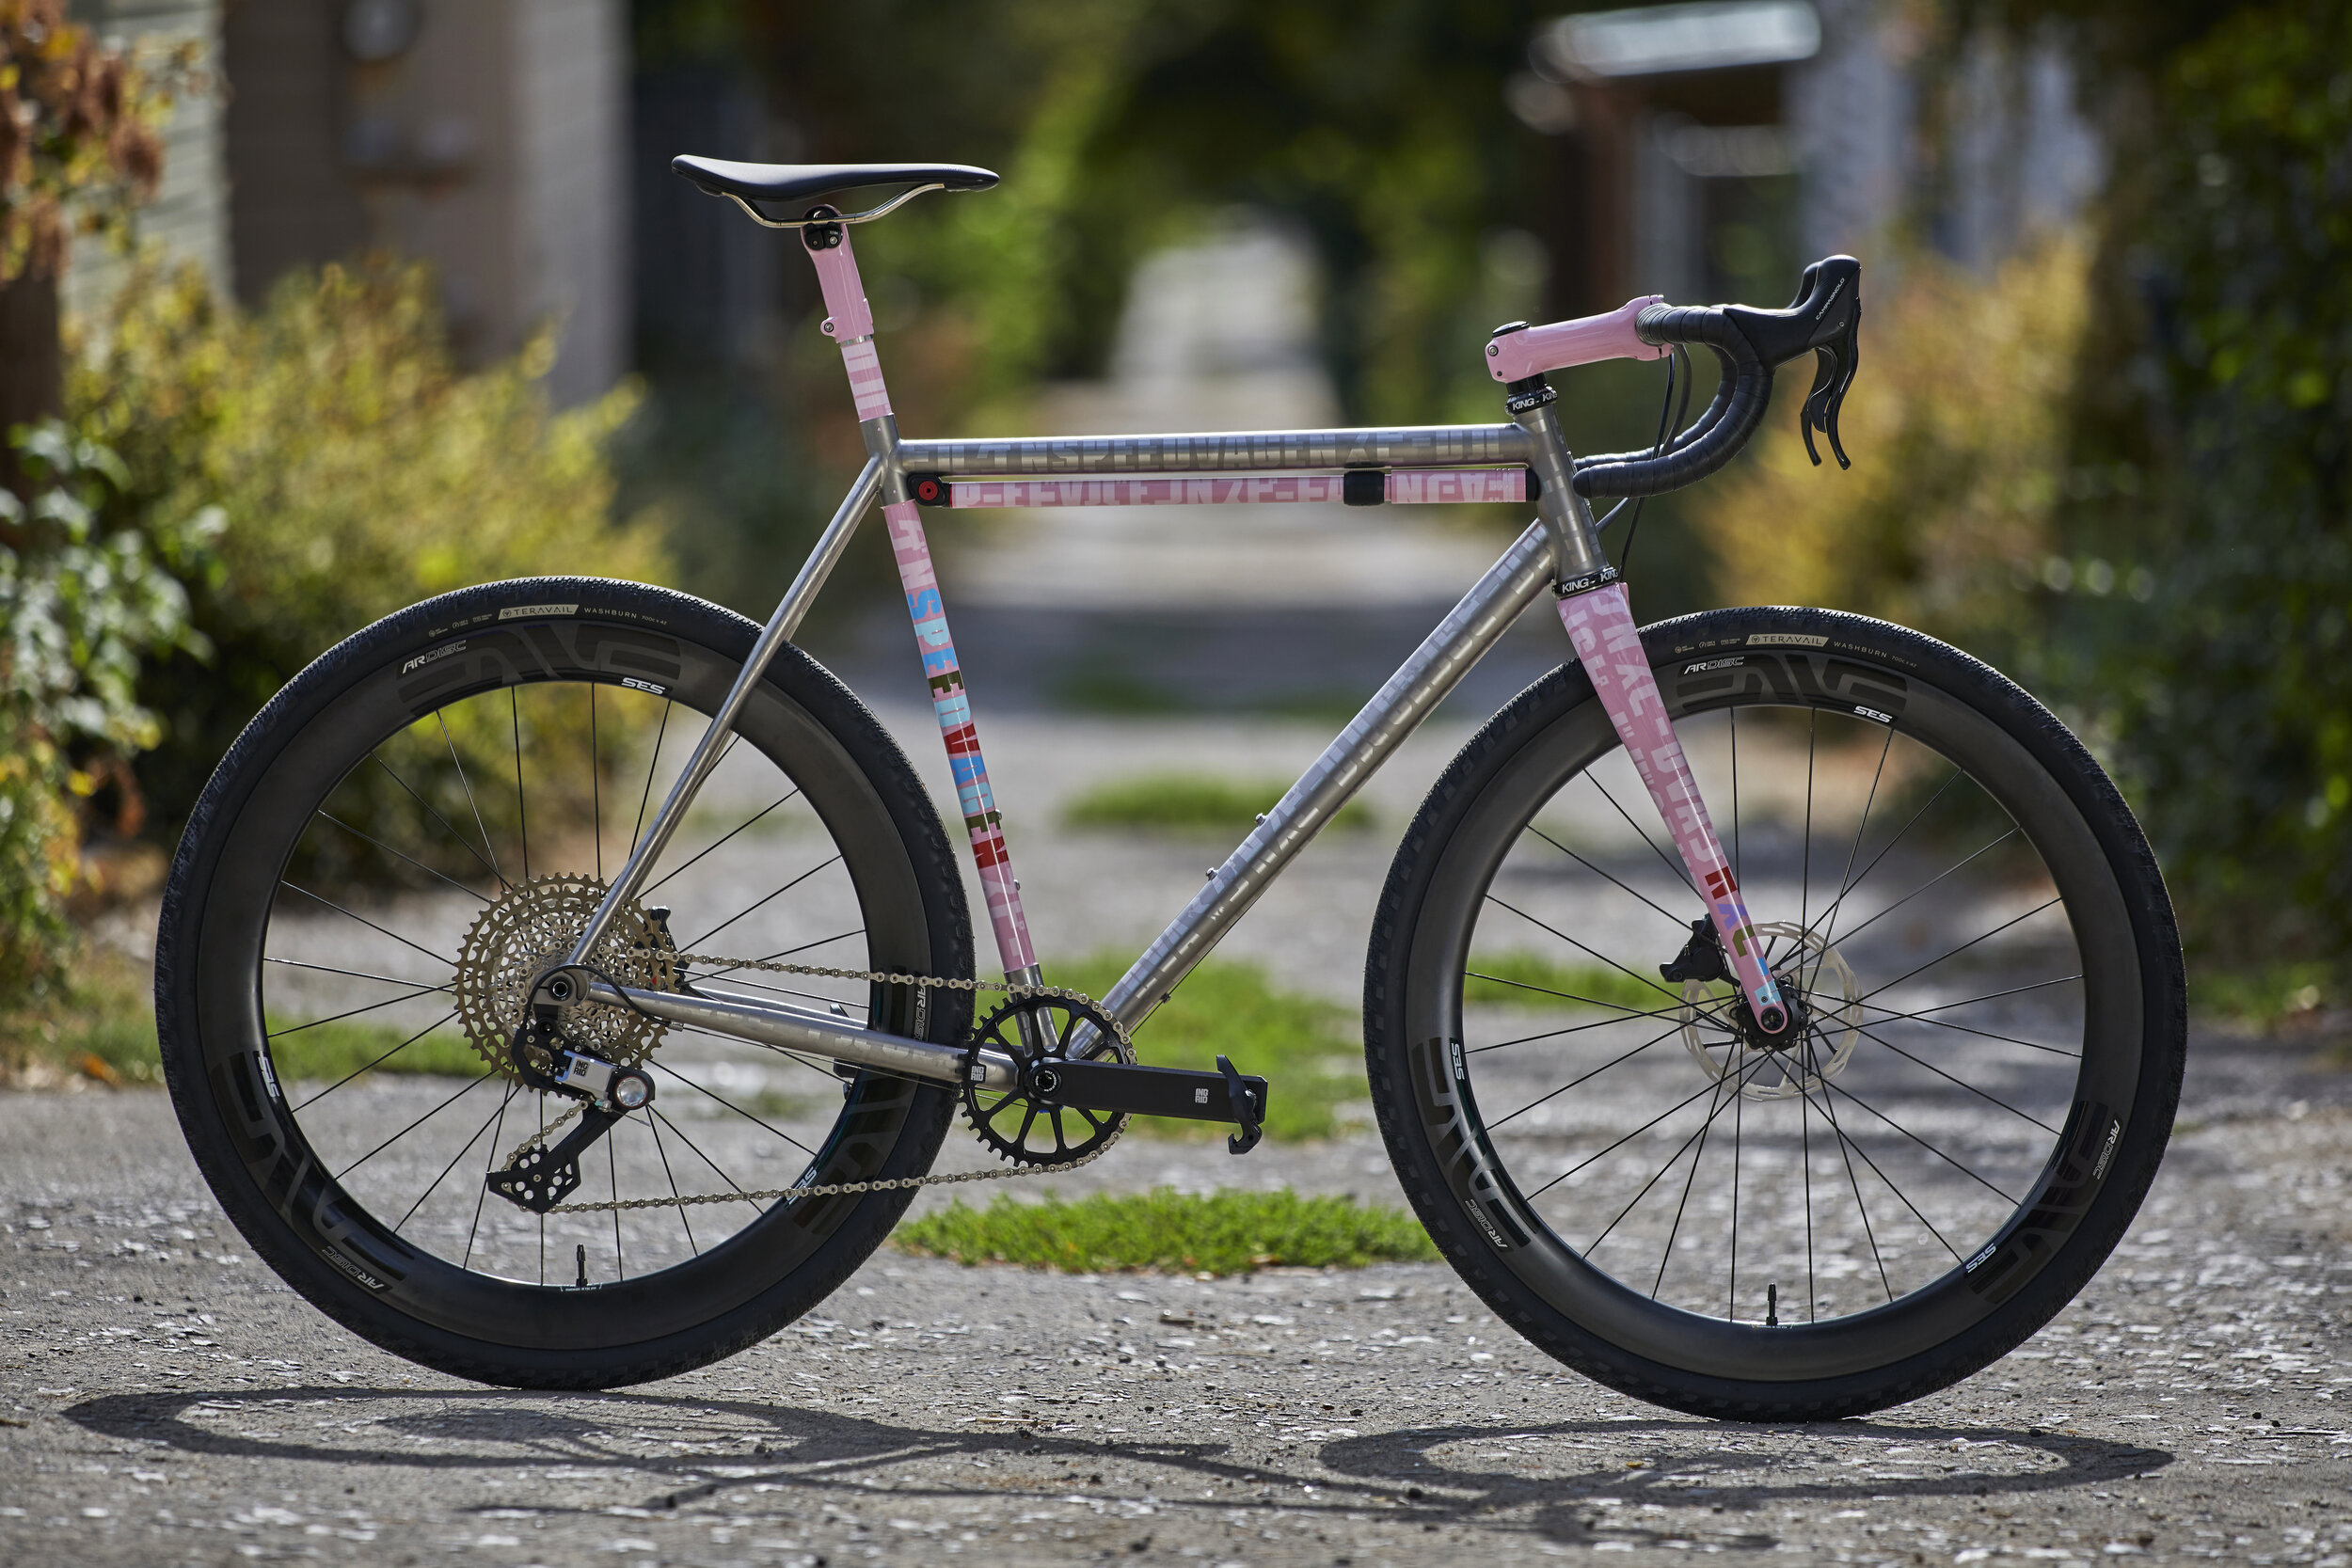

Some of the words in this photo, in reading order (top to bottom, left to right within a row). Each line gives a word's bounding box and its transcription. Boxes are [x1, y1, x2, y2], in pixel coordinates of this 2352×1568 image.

[1513, 398, 1534, 410] KING
[1562, 578, 1589, 594] KING
[514, 607, 574, 615] TERAVAIL
[584, 608, 637, 619] WASHBURN
[1762, 636, 1823, 645] TERAVAIL
[1834, 641, 1888, 658] WASHBURN
[621, 677, 665, 695] SES
[1853, 705, 1893, 723] SES
[1451, 1042, 1465, 1081] SES
[1965, 1243, 1996, 1273] SES
